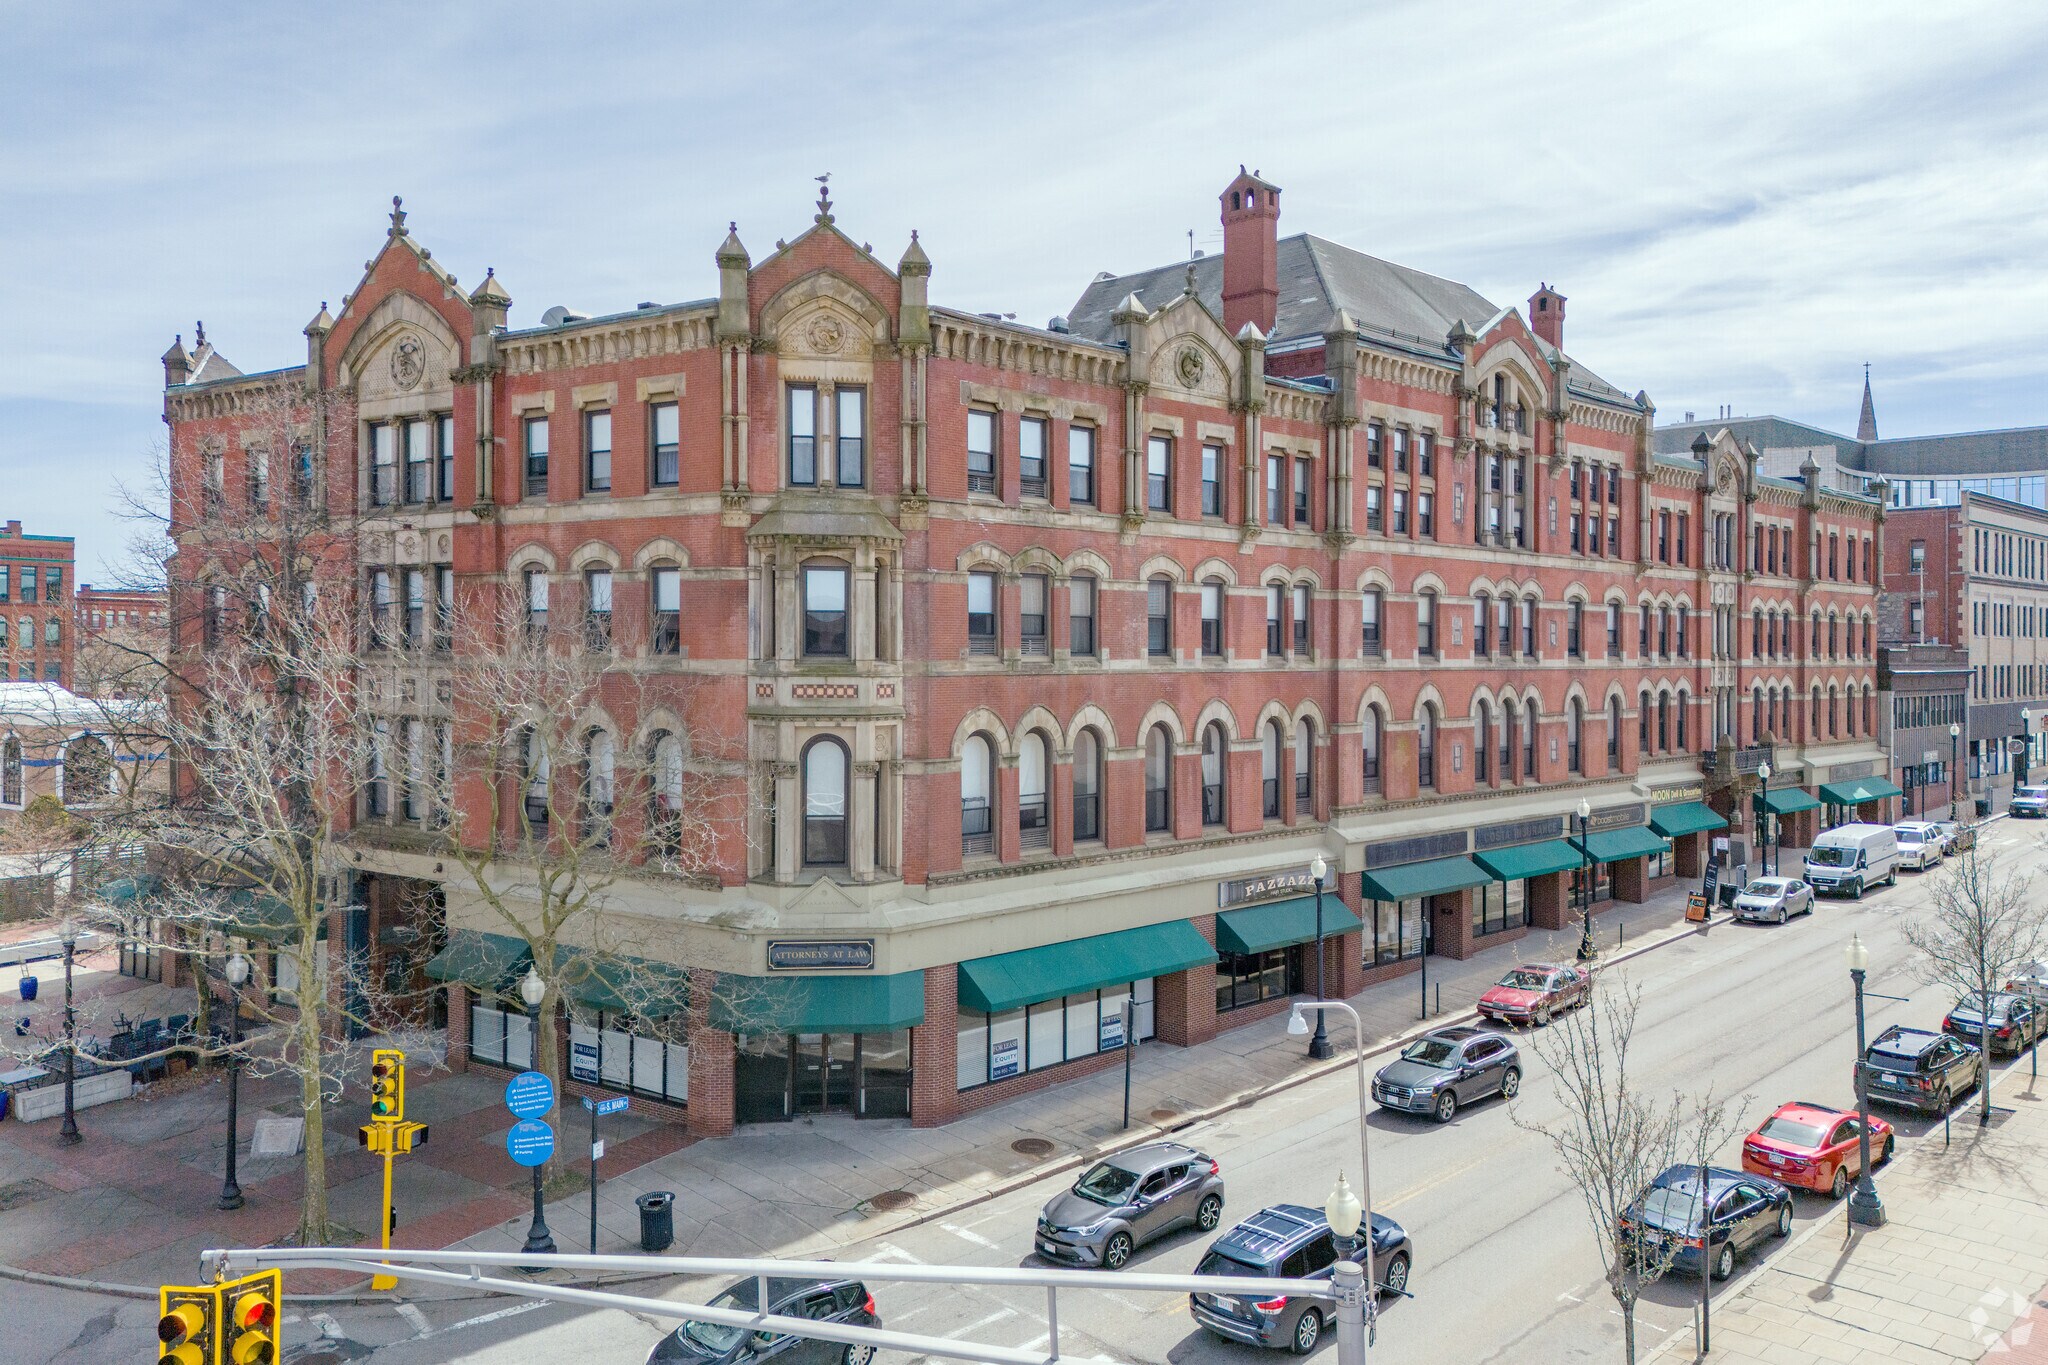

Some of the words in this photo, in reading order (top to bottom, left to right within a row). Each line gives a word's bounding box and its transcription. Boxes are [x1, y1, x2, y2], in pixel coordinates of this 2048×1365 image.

[1651, 789, 1670, 801] MOON
[1245, 875, 1315, 897] PAZZAZZ
[774, 950, 829, 959] ATTORNEYS
[832, 950, 844, 959] AT
[848, 950, 868, 958] LAW
[1103, 1026, 1122, 1035] EQUITY
[575, 1056, 596, 1066] EQUITY
[995, 1053, 1016, 1063] EQUITY
[612, 1099, 624, 1110] MAIN
